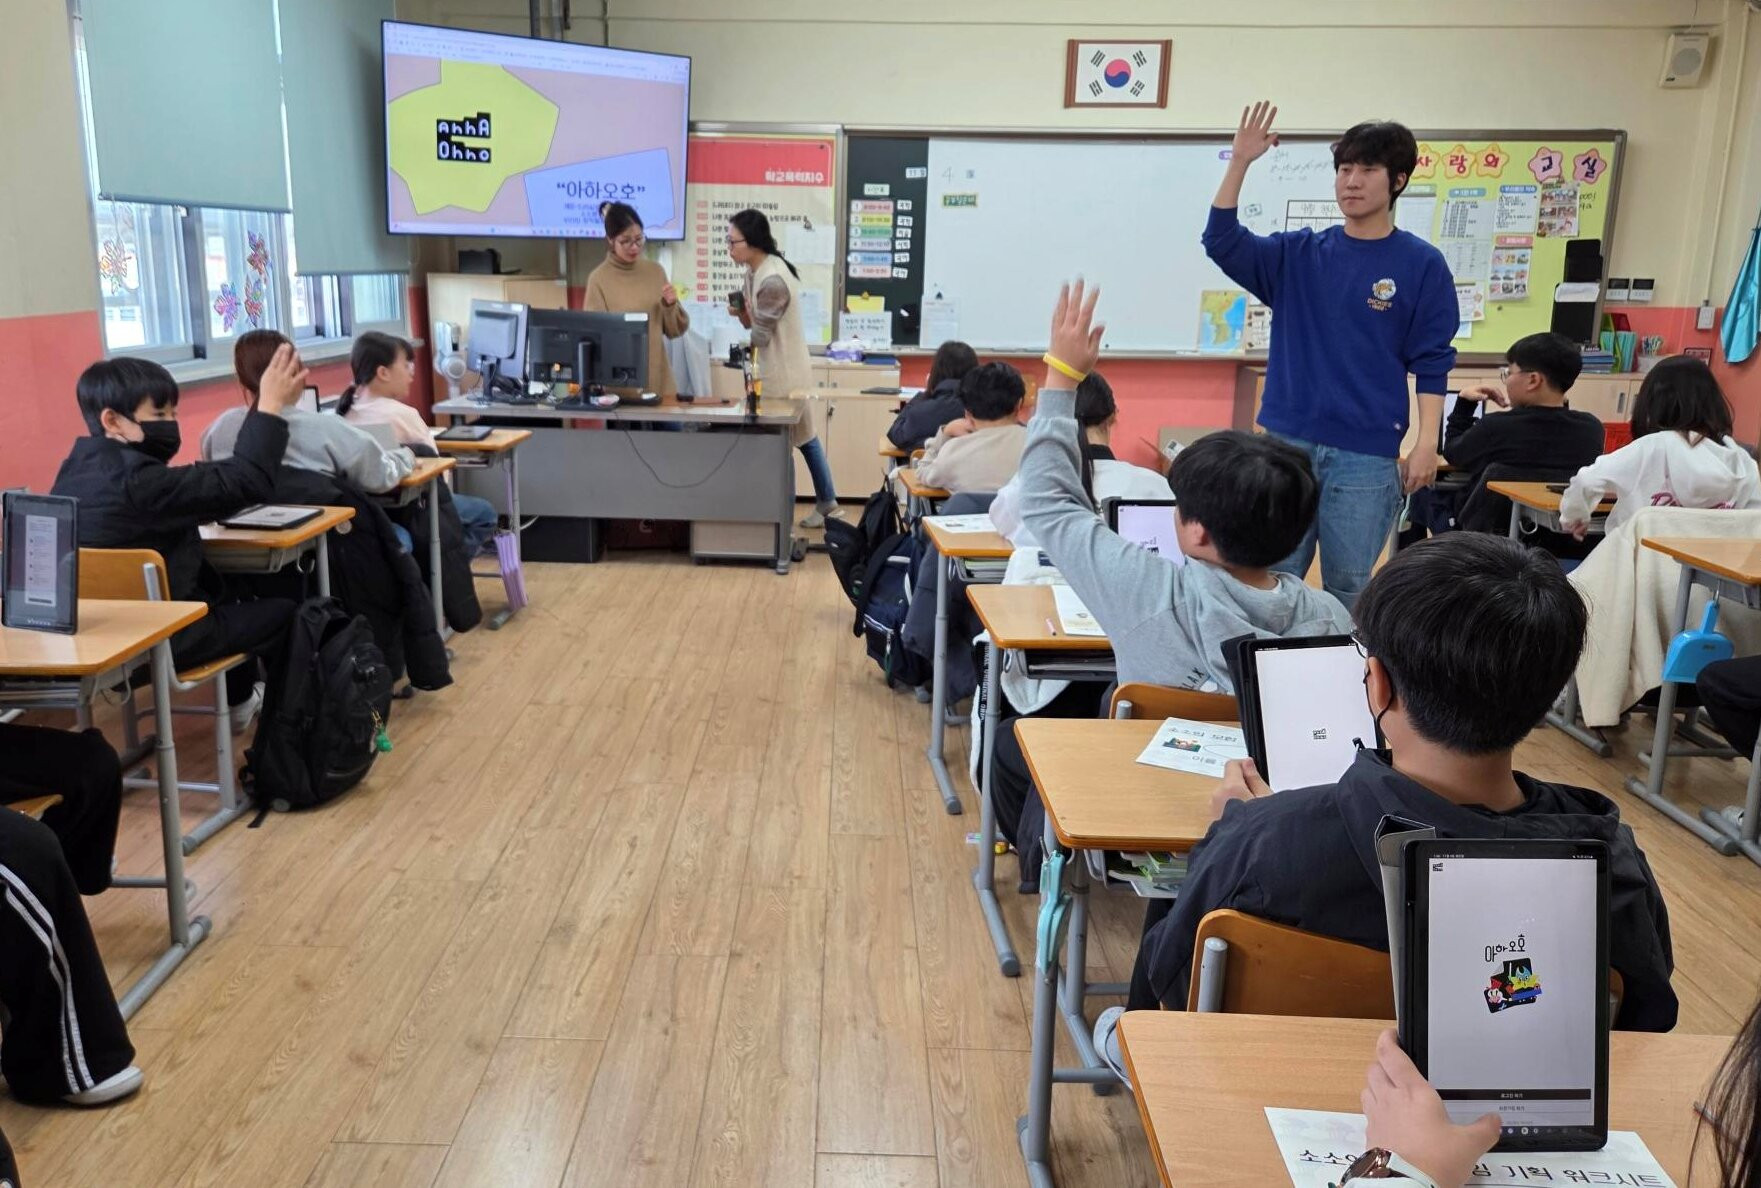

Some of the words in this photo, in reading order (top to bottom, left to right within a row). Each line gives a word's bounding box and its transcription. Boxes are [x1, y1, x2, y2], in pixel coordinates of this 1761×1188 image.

[1484, 933, 1526, 963] 아하오호
[1501, 1165, 1553, 1180] 기획
[1563, 1169, 1667, 1188] 워크시트
